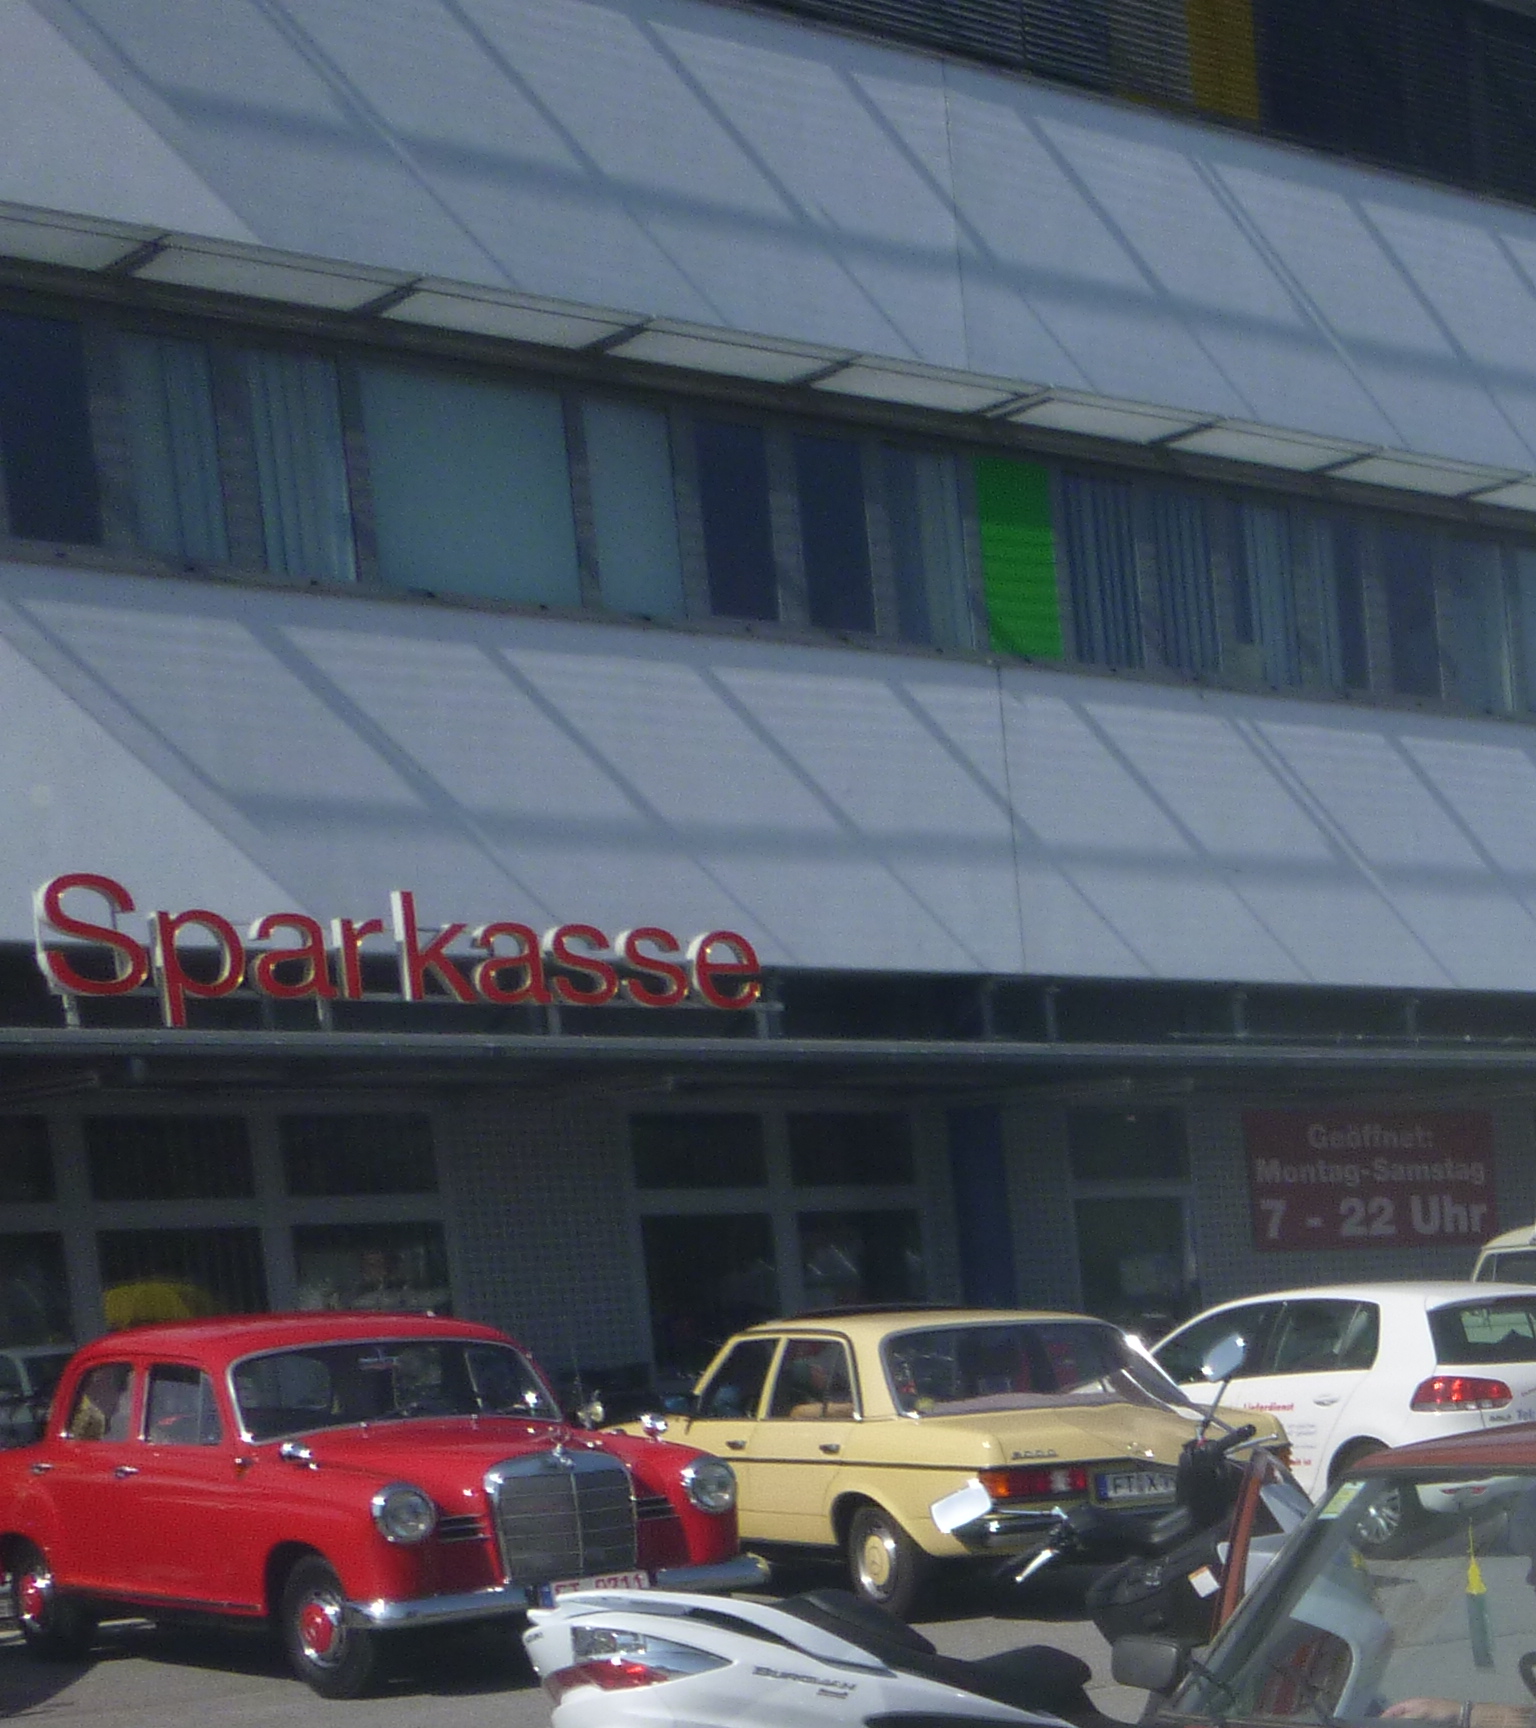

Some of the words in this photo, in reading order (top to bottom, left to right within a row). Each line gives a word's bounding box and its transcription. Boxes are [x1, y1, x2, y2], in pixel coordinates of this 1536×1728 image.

[36, 872, 762, 1027] Sparkasse
[1260, 1203, 1286, 1239] 7
[1340, 1198, 1396, 1236] 22
[1410, 1194, 1488, 1235] Uhr
